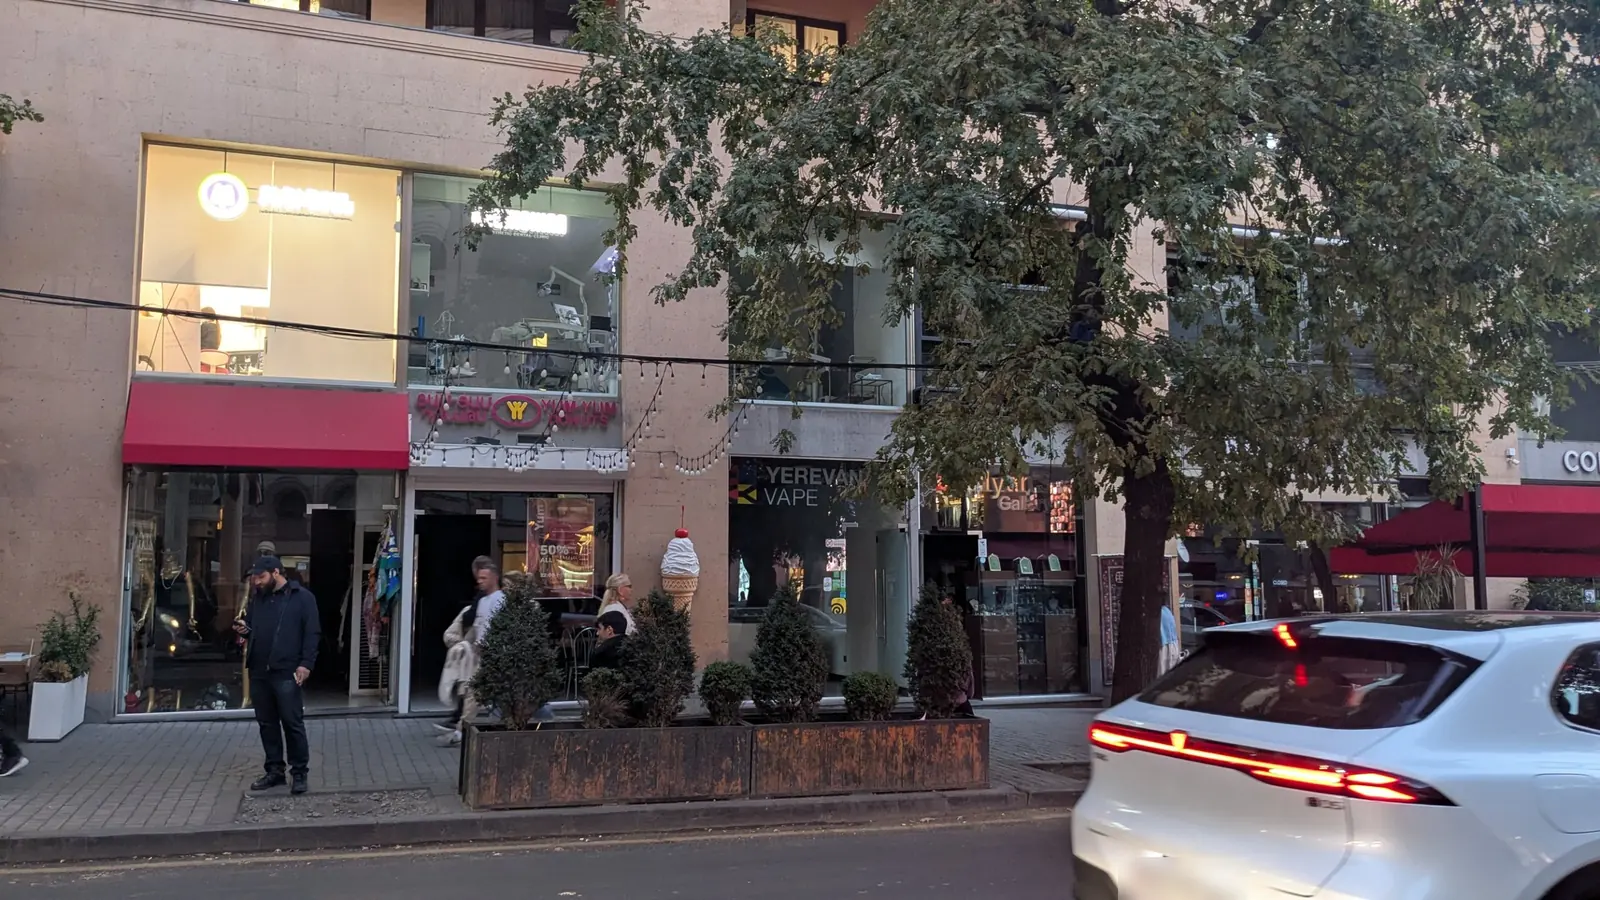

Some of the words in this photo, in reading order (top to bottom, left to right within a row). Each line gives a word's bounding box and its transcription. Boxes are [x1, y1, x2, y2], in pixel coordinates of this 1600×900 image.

[765, 465, 863, 486] YEREVAN
[763, 487, 819, 507] VAPE
[540, 544, 569, 556] 50%
